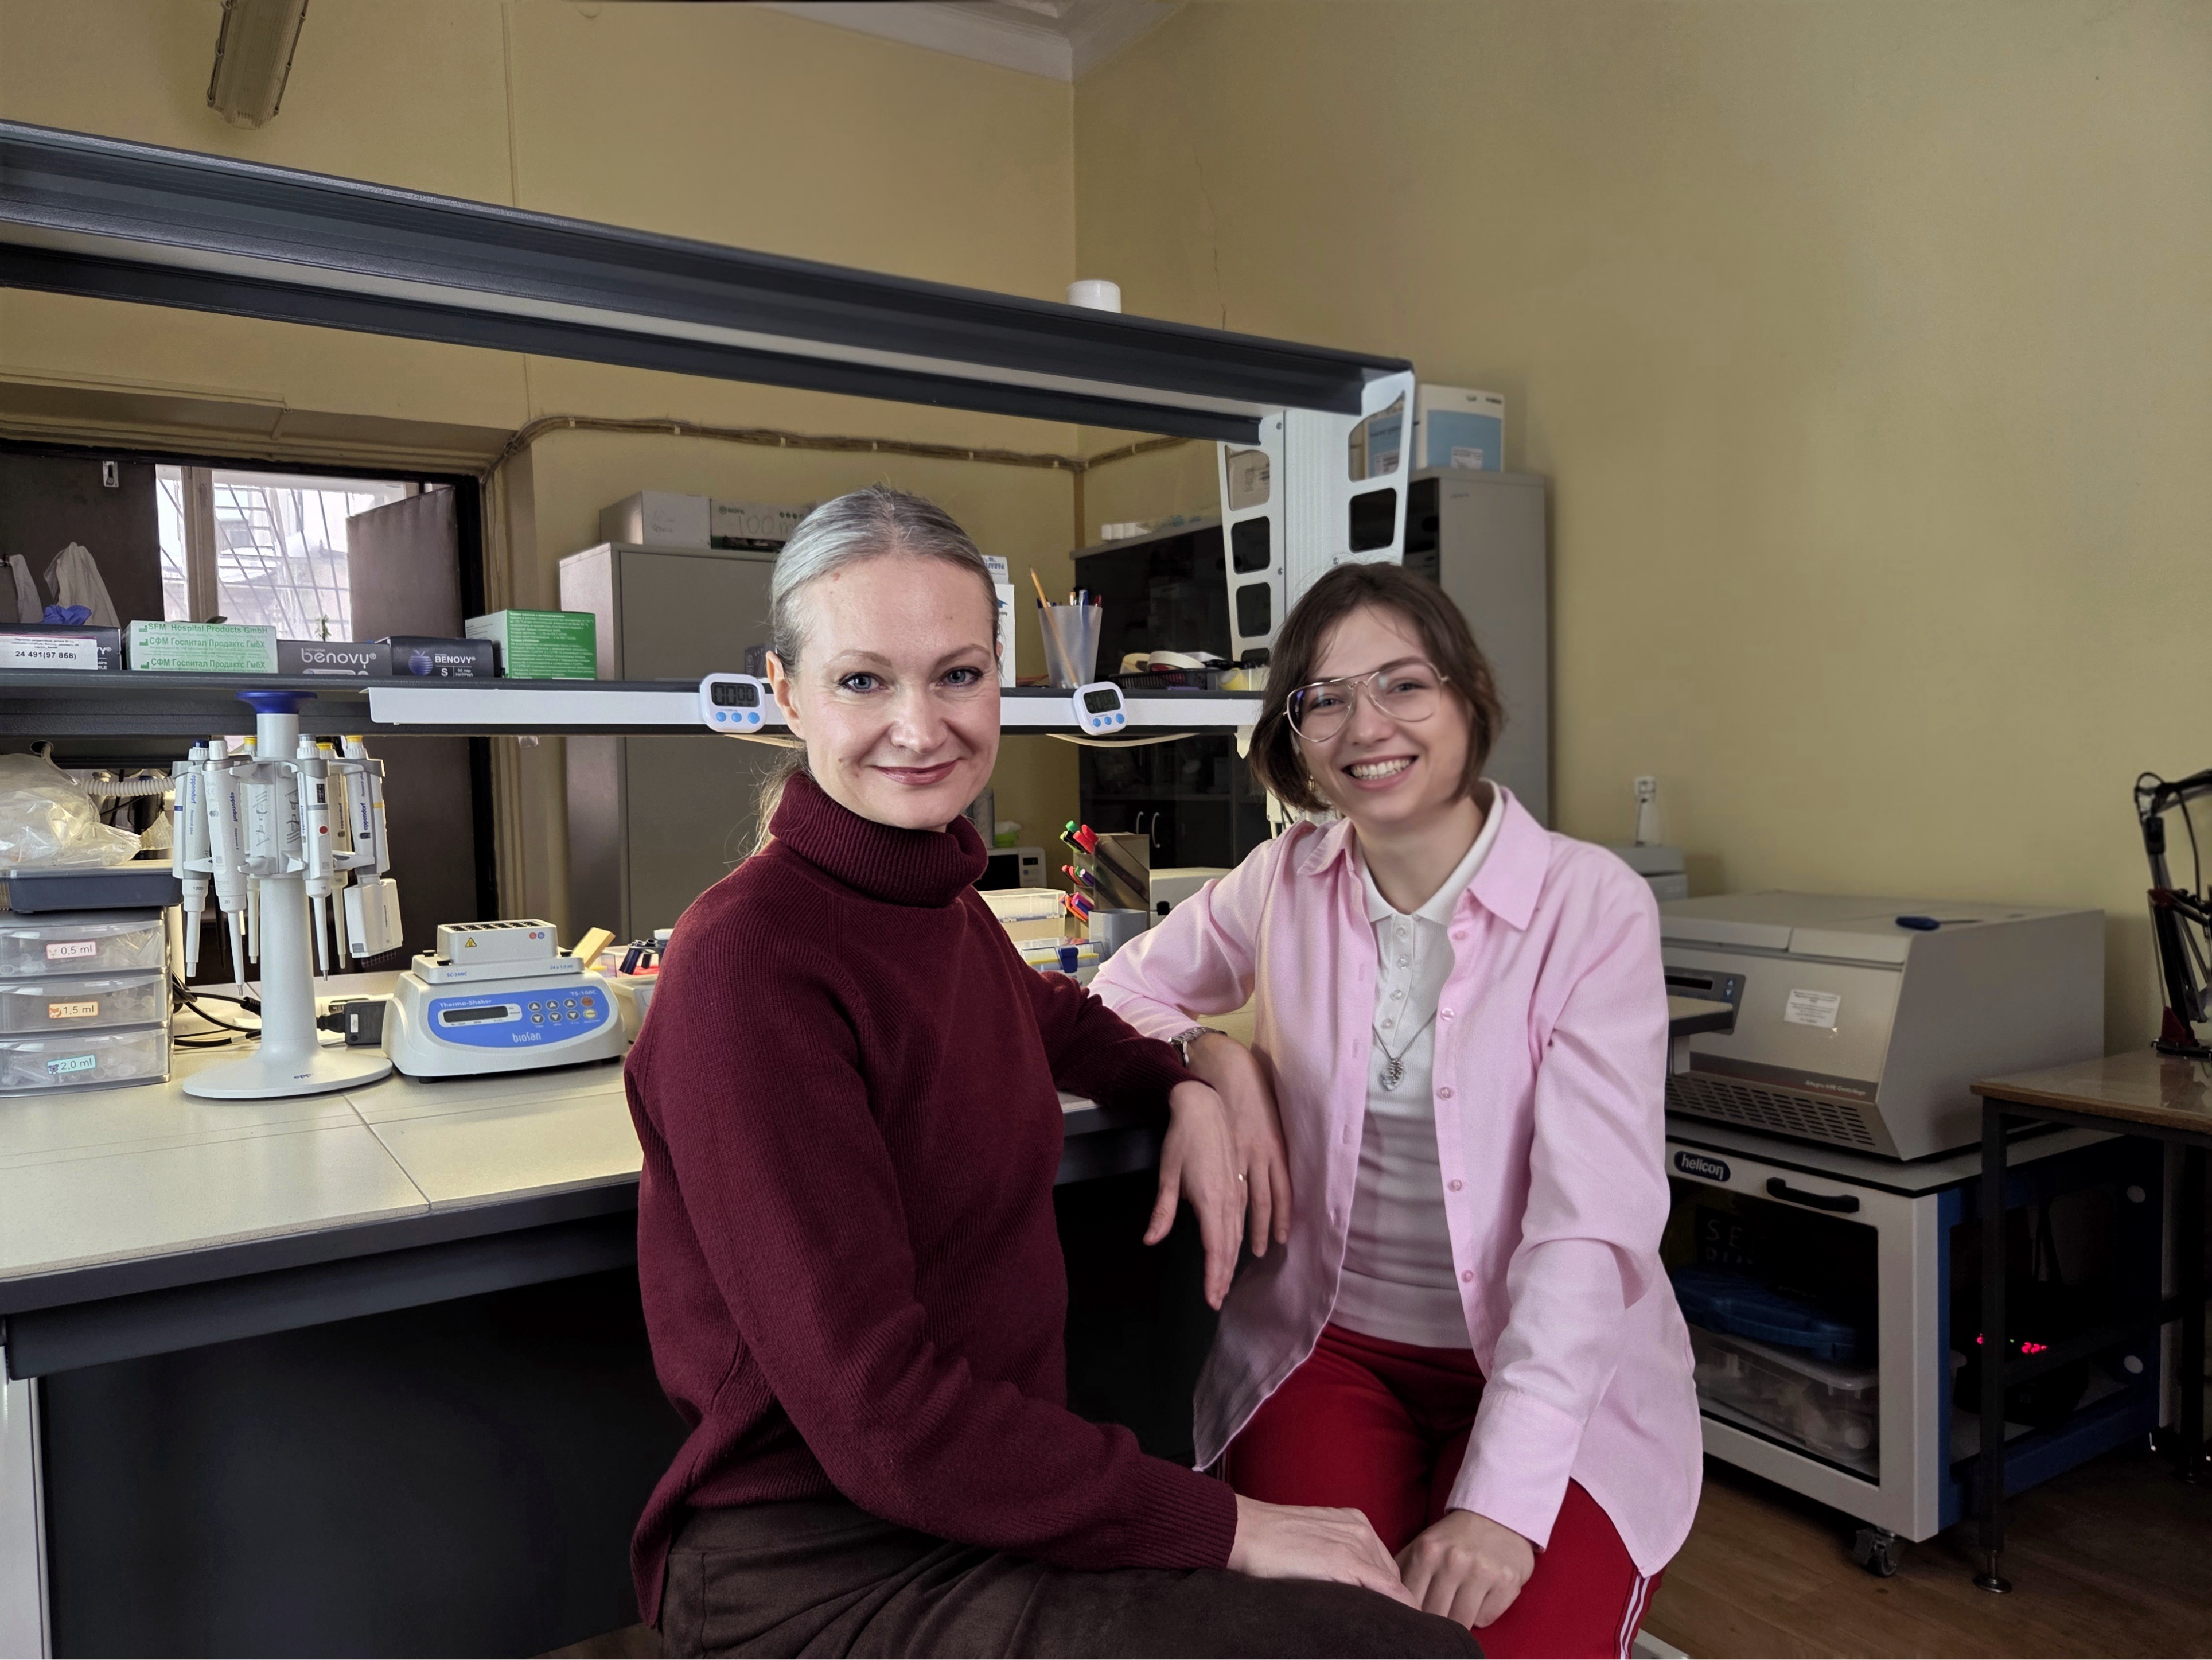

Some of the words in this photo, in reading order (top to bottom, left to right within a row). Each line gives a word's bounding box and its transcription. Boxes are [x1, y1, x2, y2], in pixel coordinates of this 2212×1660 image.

[739, 515, 775, 536] 100
[171, 624, 204, 632] Hospital
[206, 625, 242, 633] Products
[149, 637, 169, 646] СФМ
[171, 637, 207, 646] Госпитал
[209, 639, 244, 648] Продактс
[246, 640, 265, 648] ГмбХ
[28, 651, 56, 660] 491(97
[59, 652, 77, 660] 858)
[151, 658, 170, 667] СФМ
[172, 659, 208, 667] Госпитал
[209, 660, 244, 669] Продактс
[441, 667, 448, 677] S
[230, 792, 239, 822] eppendorf
[360, 802, 369, 831] eppendorf
[61, 946, 76, 955] 0,5
[80, 944, 92, 954] ml
[439, 1000, 492, 1008] Thermo-Shaker
[63, 1006, 78, 1015] 1,5
[82, 1005, 94, 1013] ml
[60, 1061, 76, 1070] 2,0
[80, 1058, 92, 1067] ml
[1681, 1153, 1724, 1180] helicon
